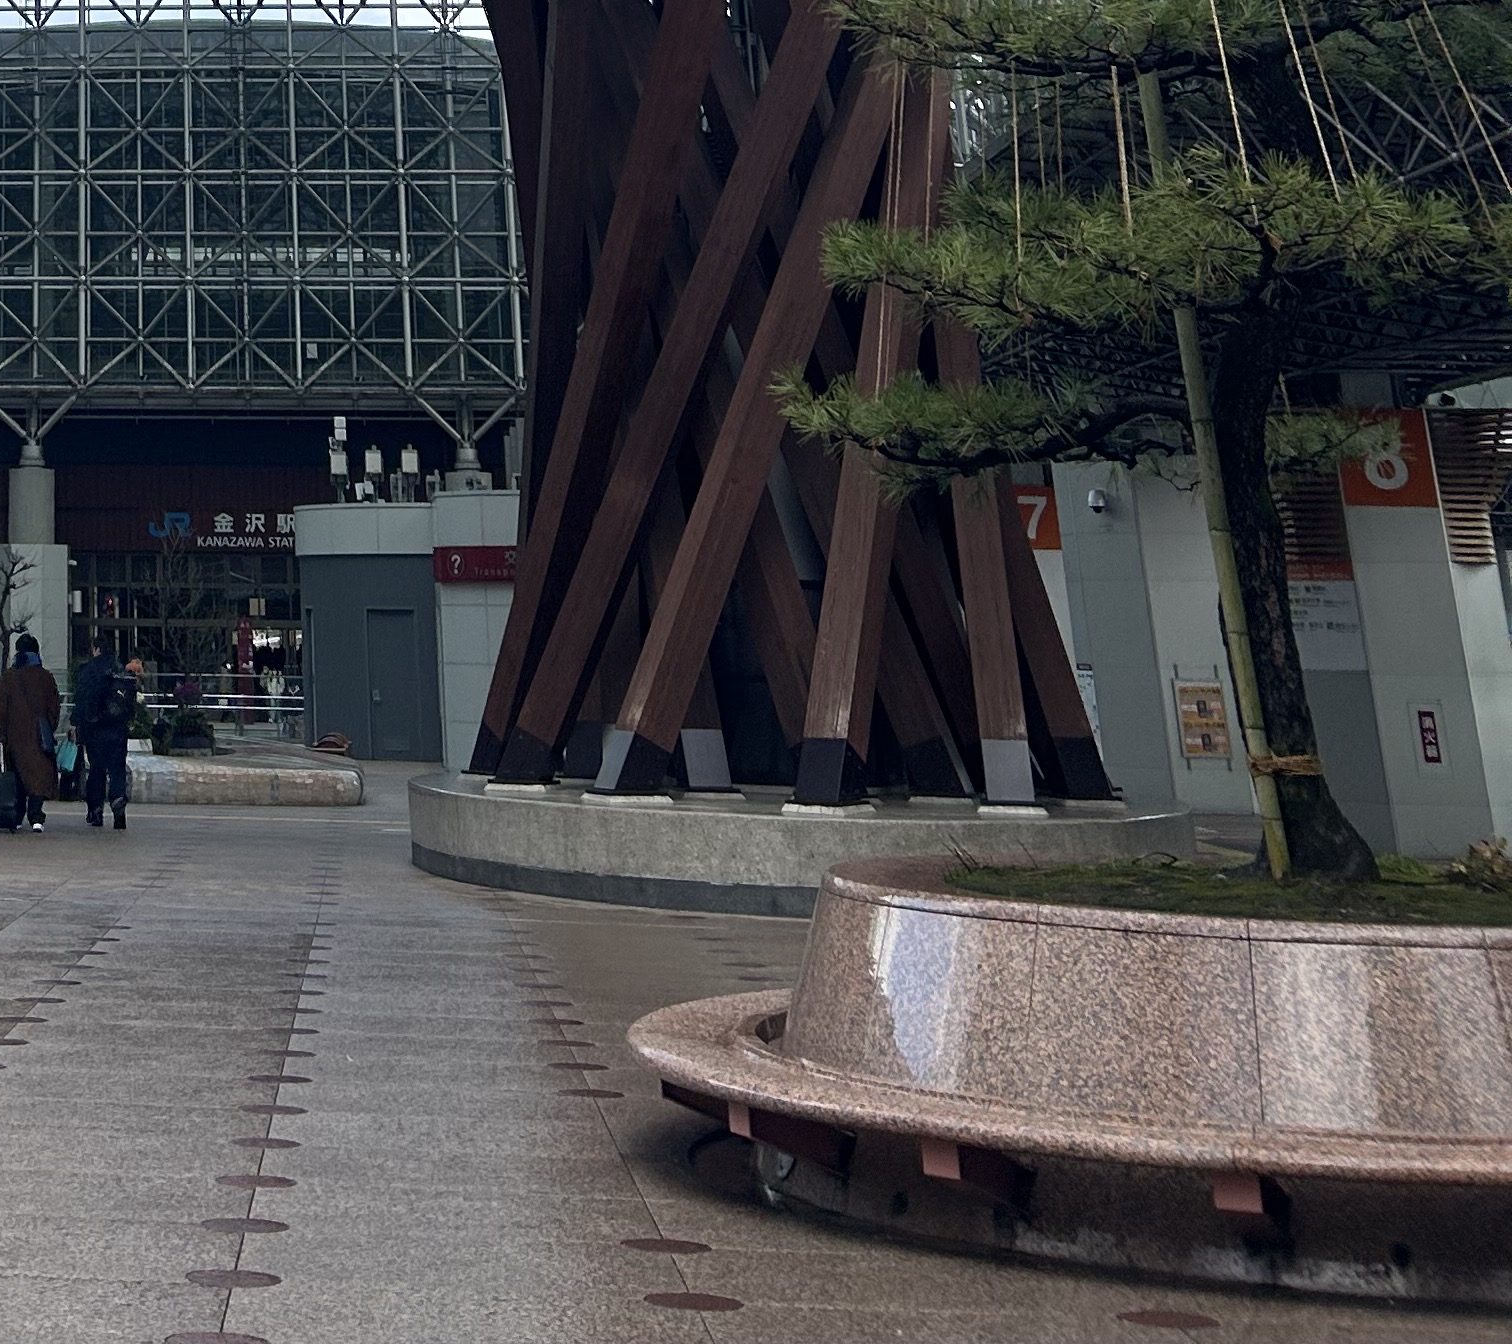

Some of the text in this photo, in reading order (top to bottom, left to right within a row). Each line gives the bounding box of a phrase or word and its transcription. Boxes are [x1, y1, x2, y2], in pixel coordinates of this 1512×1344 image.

[148, 512, 192, 537] JR
[213, 512, 295, 534] 金沢駅
[1016, 495, 1047, 539] 7
[196, 536, 265, 548] KANAZAWA
